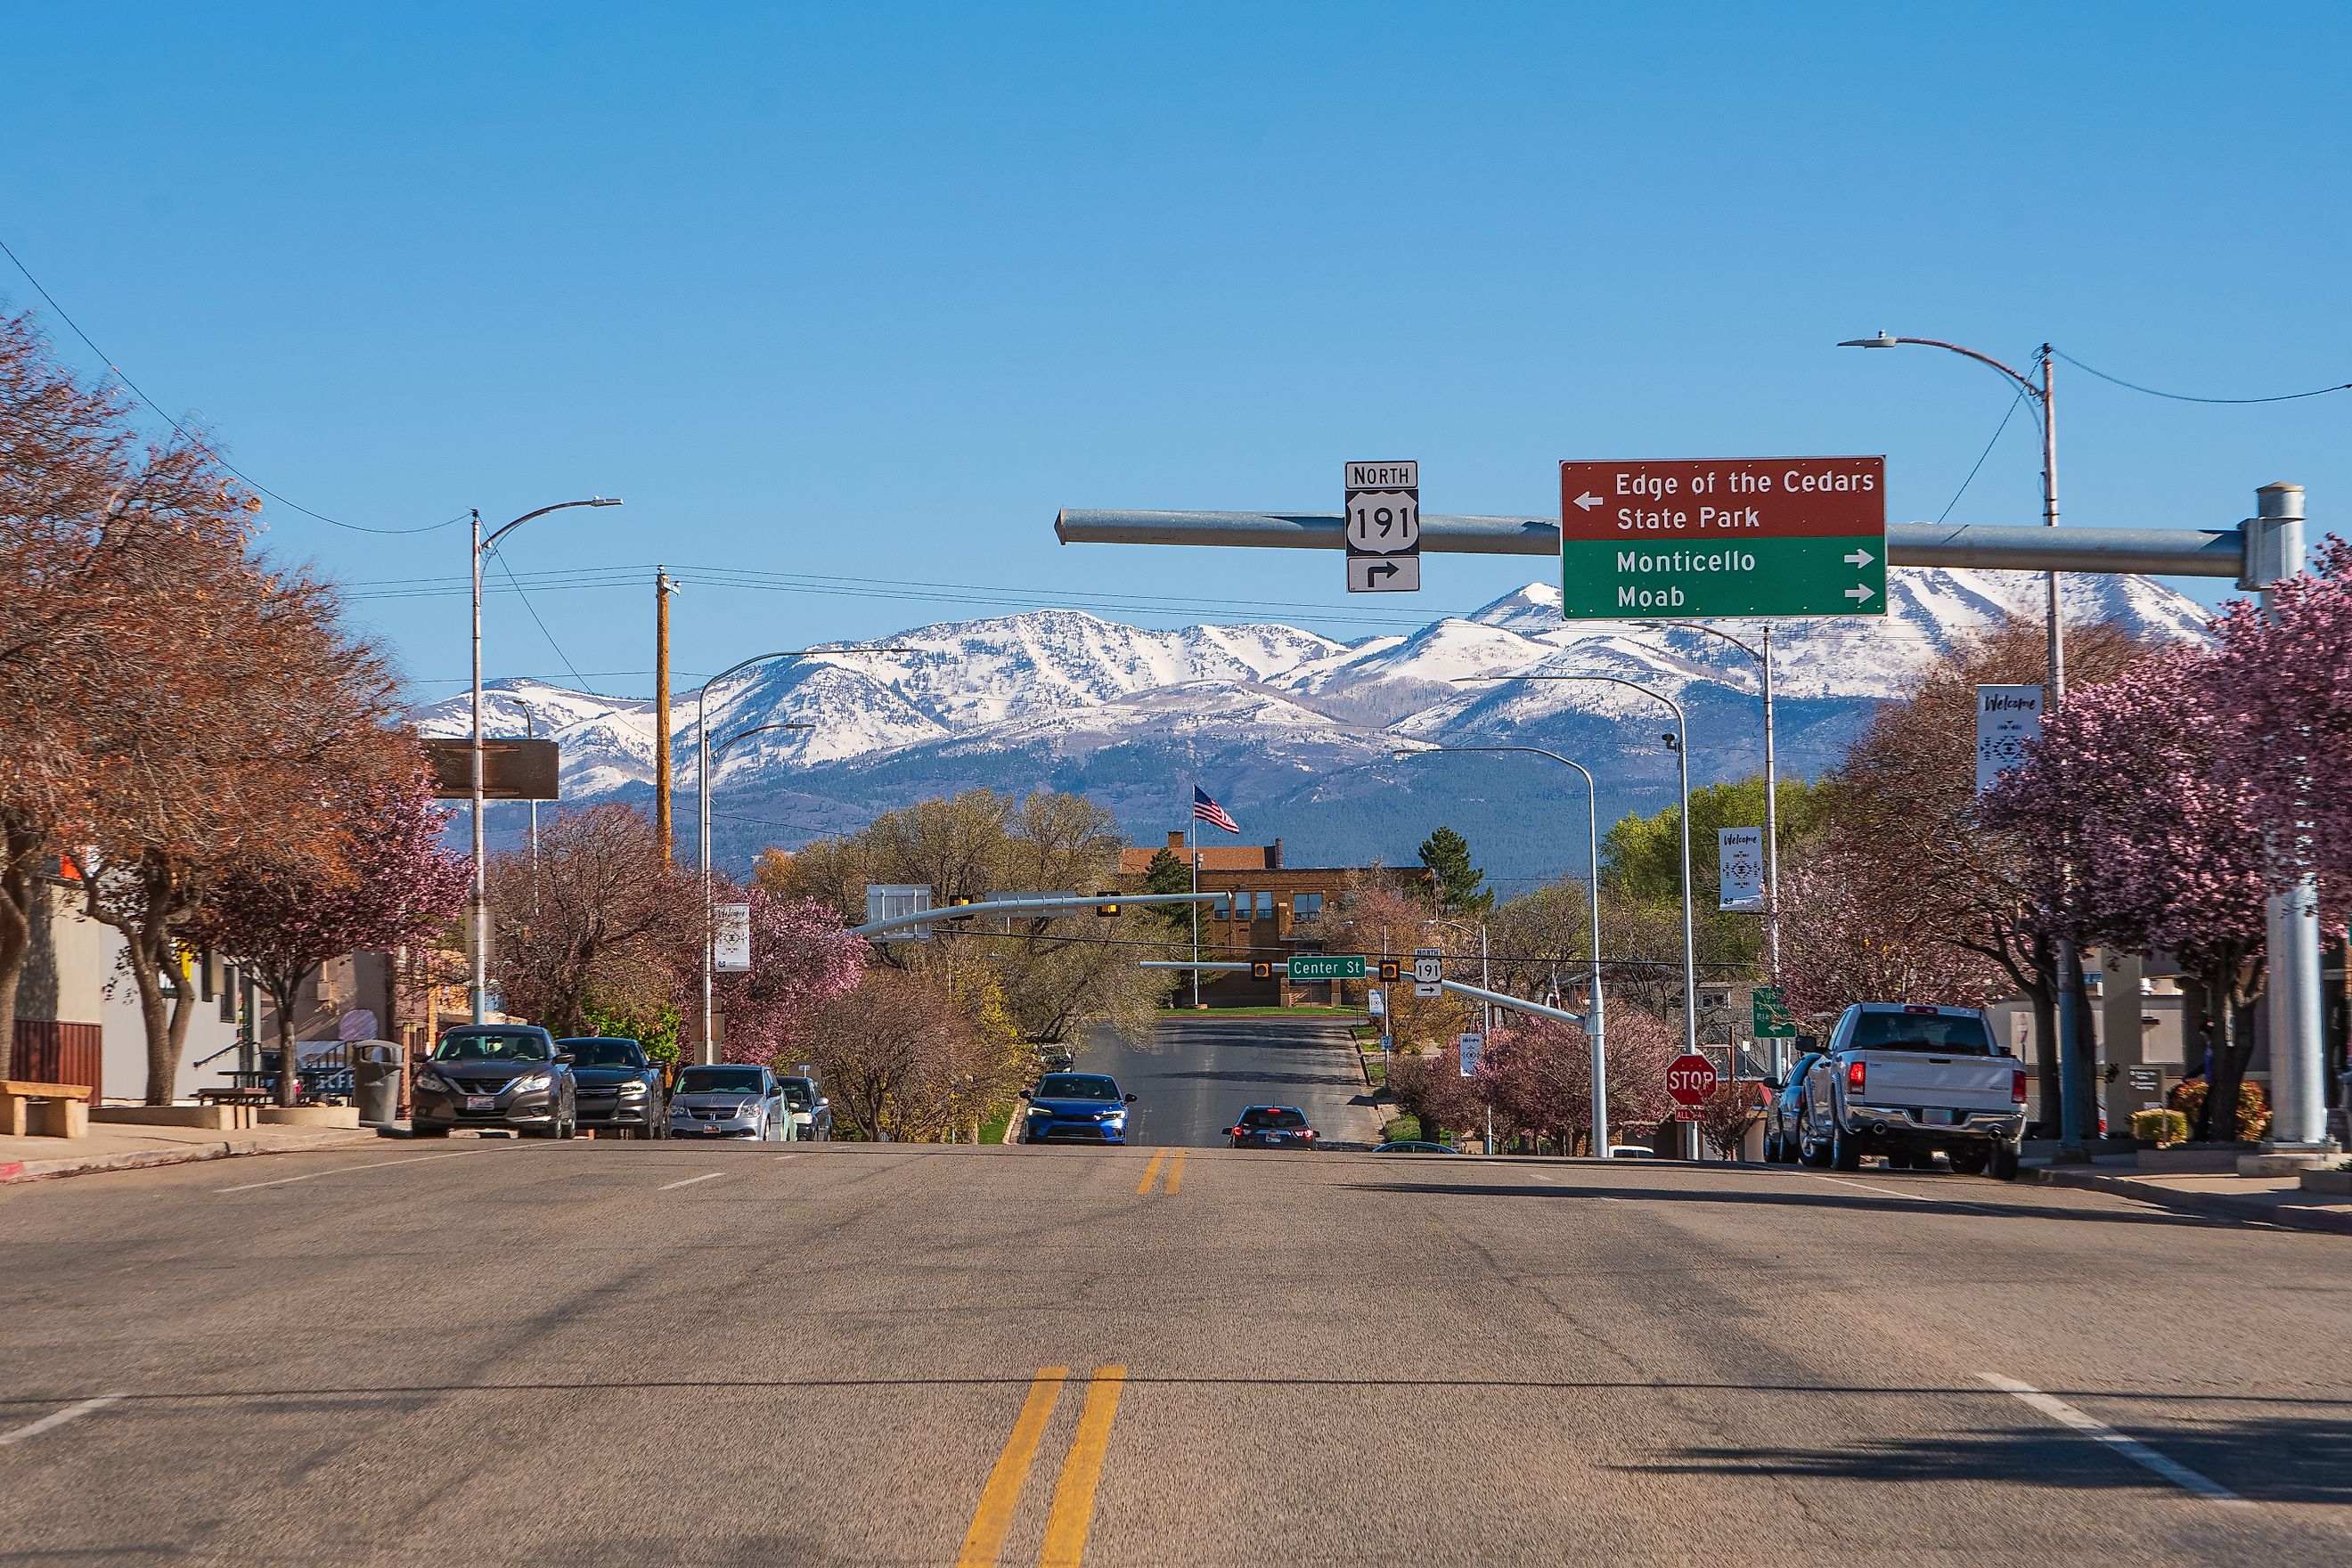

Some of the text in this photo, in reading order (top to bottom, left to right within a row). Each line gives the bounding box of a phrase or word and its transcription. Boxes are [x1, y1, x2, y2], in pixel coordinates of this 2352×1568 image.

[1354, 467, 1409, 485] NORTH
[1616, 470, 1874, 502] Edge of the Cedars
[1357, 507, 1409, 539] 191
[1617, 506, 1760, 530] State Park
[1617, 550, 1755, 573] Monticello
[1618, 585, 1685, 608] Moab
[1984, 693, 2036, 712] Welcome
[1724, 833, 1758, 845] Welcome
[1417, 949, 1439, 957] NORTH
[1294, 960, 1360, 975] Center St
[1417, 964, 1438, 977] 191
[1669, 1071, 1714, 1090] STOP
[1677, 1111, 1690, 1119] ALL
